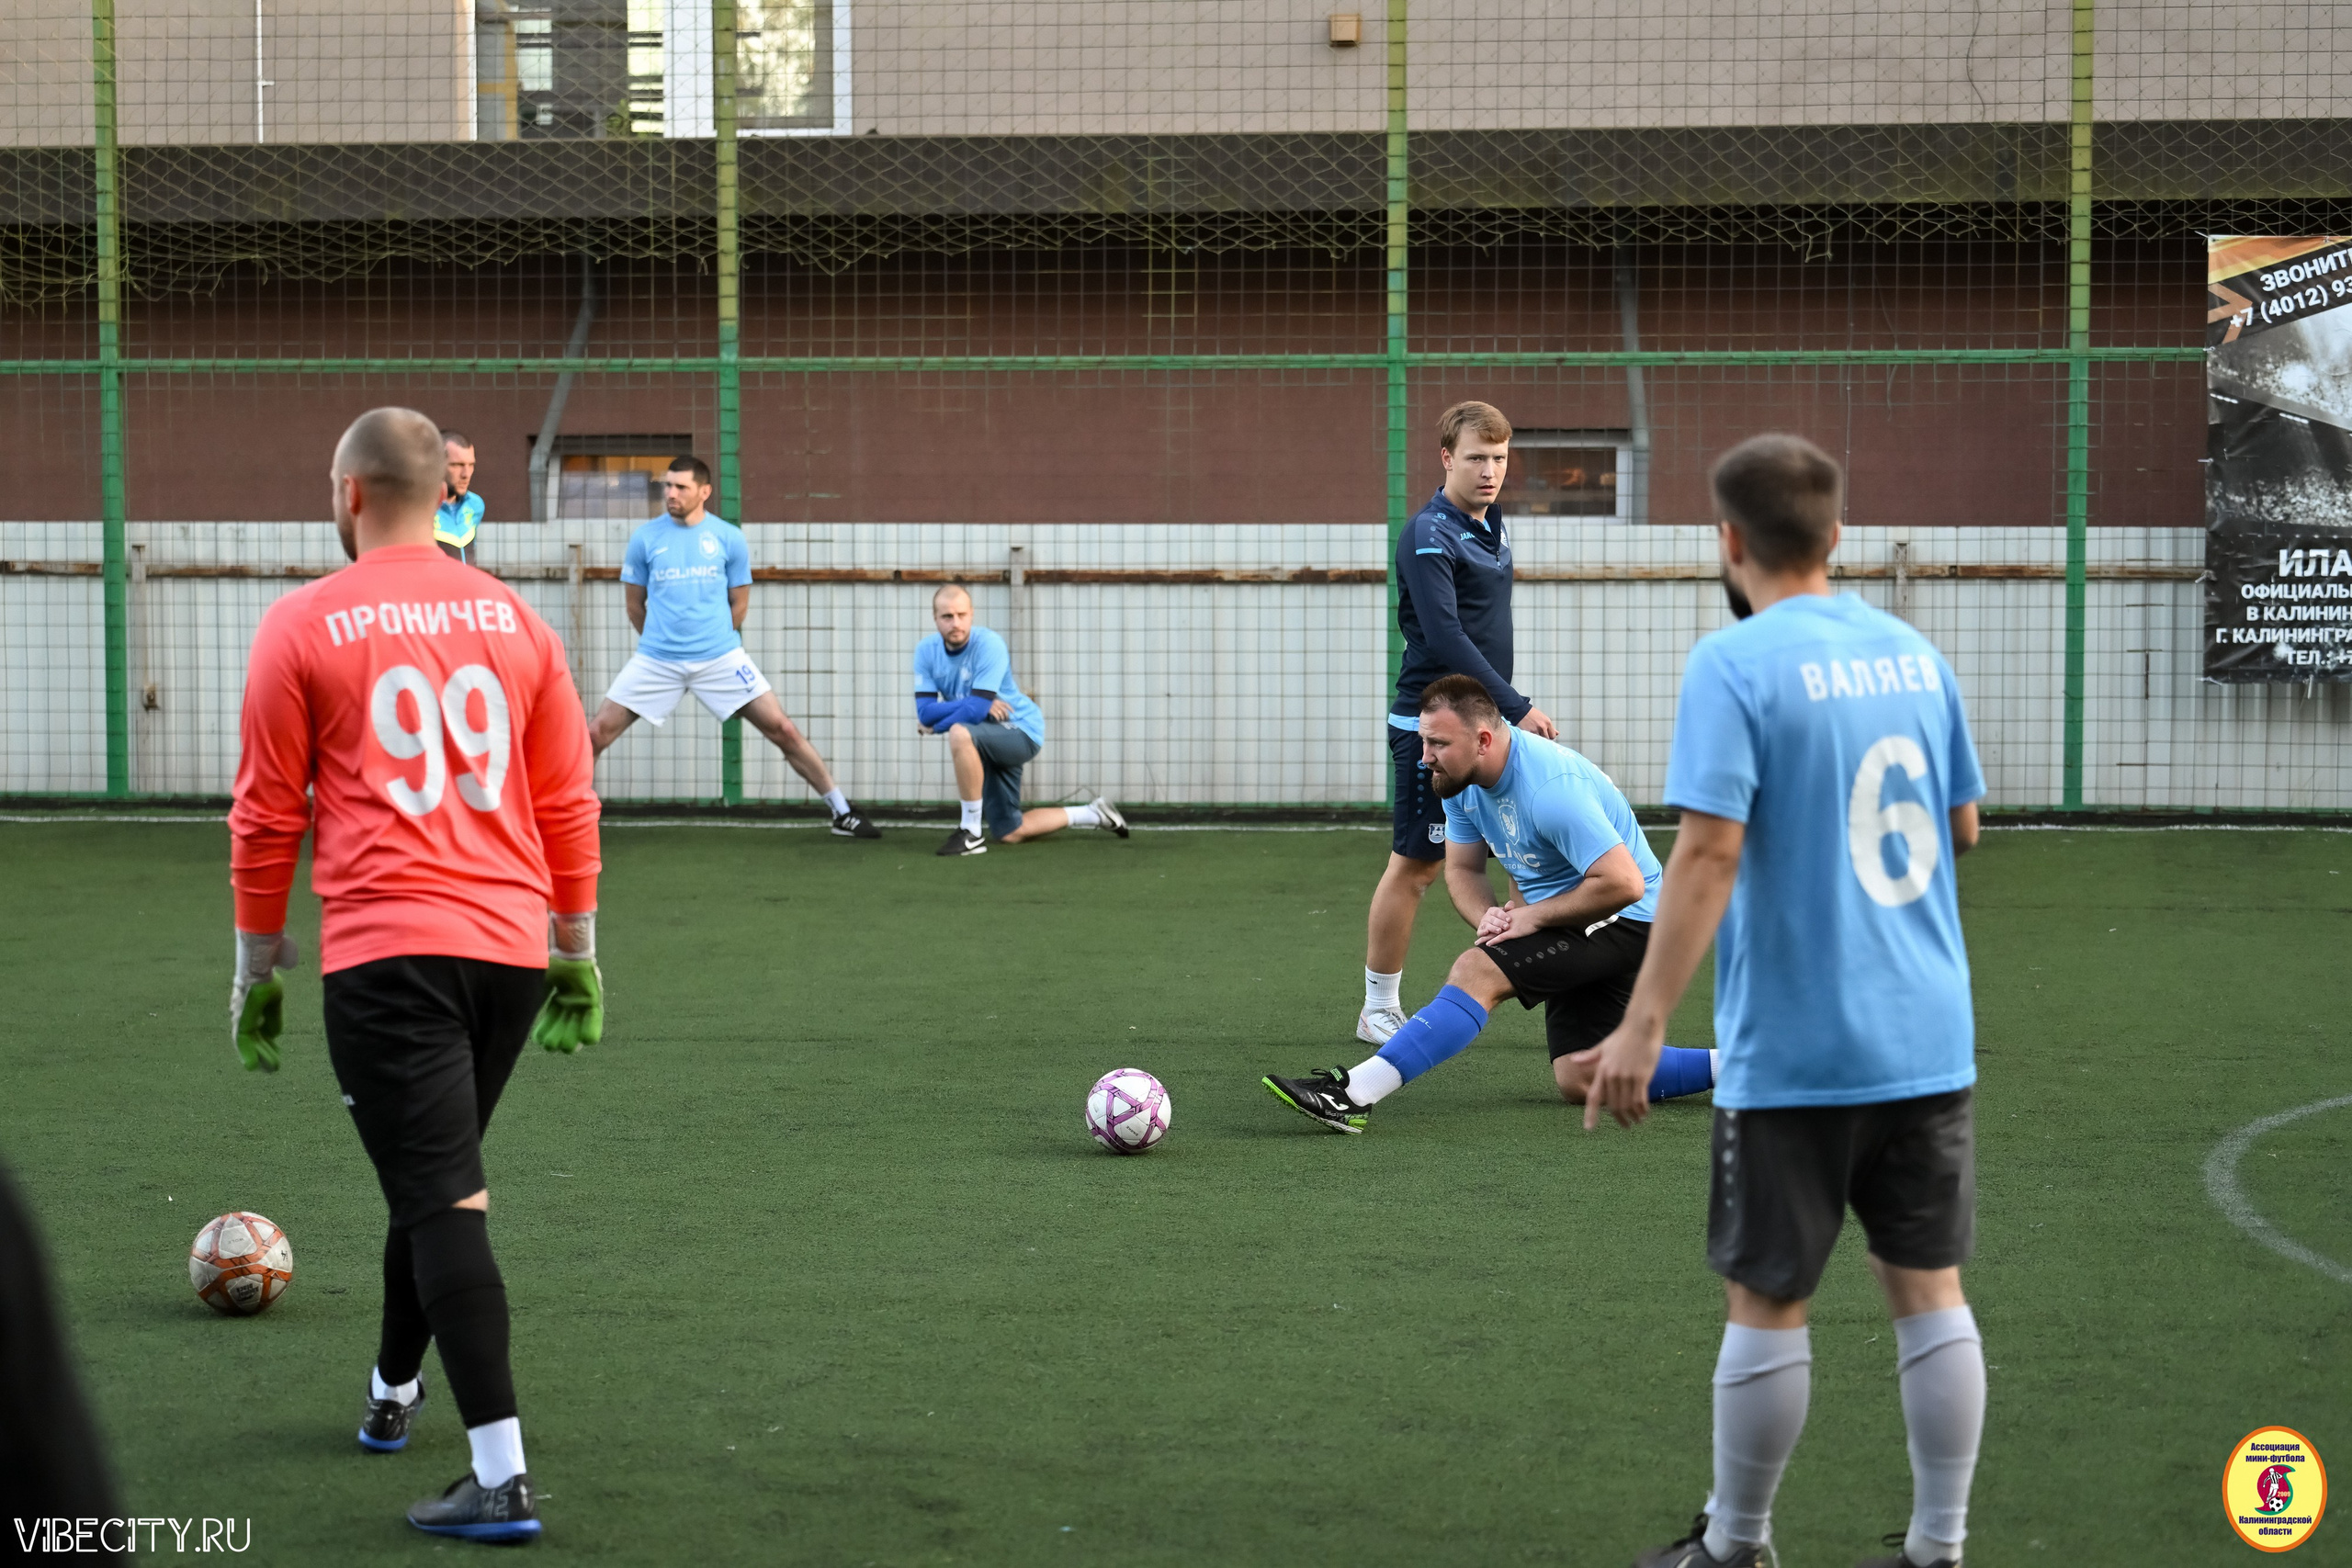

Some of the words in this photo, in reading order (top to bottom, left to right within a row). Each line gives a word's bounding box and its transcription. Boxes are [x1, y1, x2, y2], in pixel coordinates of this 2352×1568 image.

[2230, 306, 2254, 328] +7
[2260, 284, 2329, 324] (4012)
[2278, 548, 2352, 578] ИЛА
[2241, 583, 2352, 602] ОФИЦИАЛЬ
[324, 599, 517, 647] ПРОНИЧЕВ
[2246, 605, 2260, 621] В
[2215, 627, 2229, 644] Г.
[735, 664, 756, 685] 19
[1798, 653, 1940, 703] ВАЛЯЕВ
[370, 663, 511, 816] 99
[1848, 735, 1939, 908] 6
